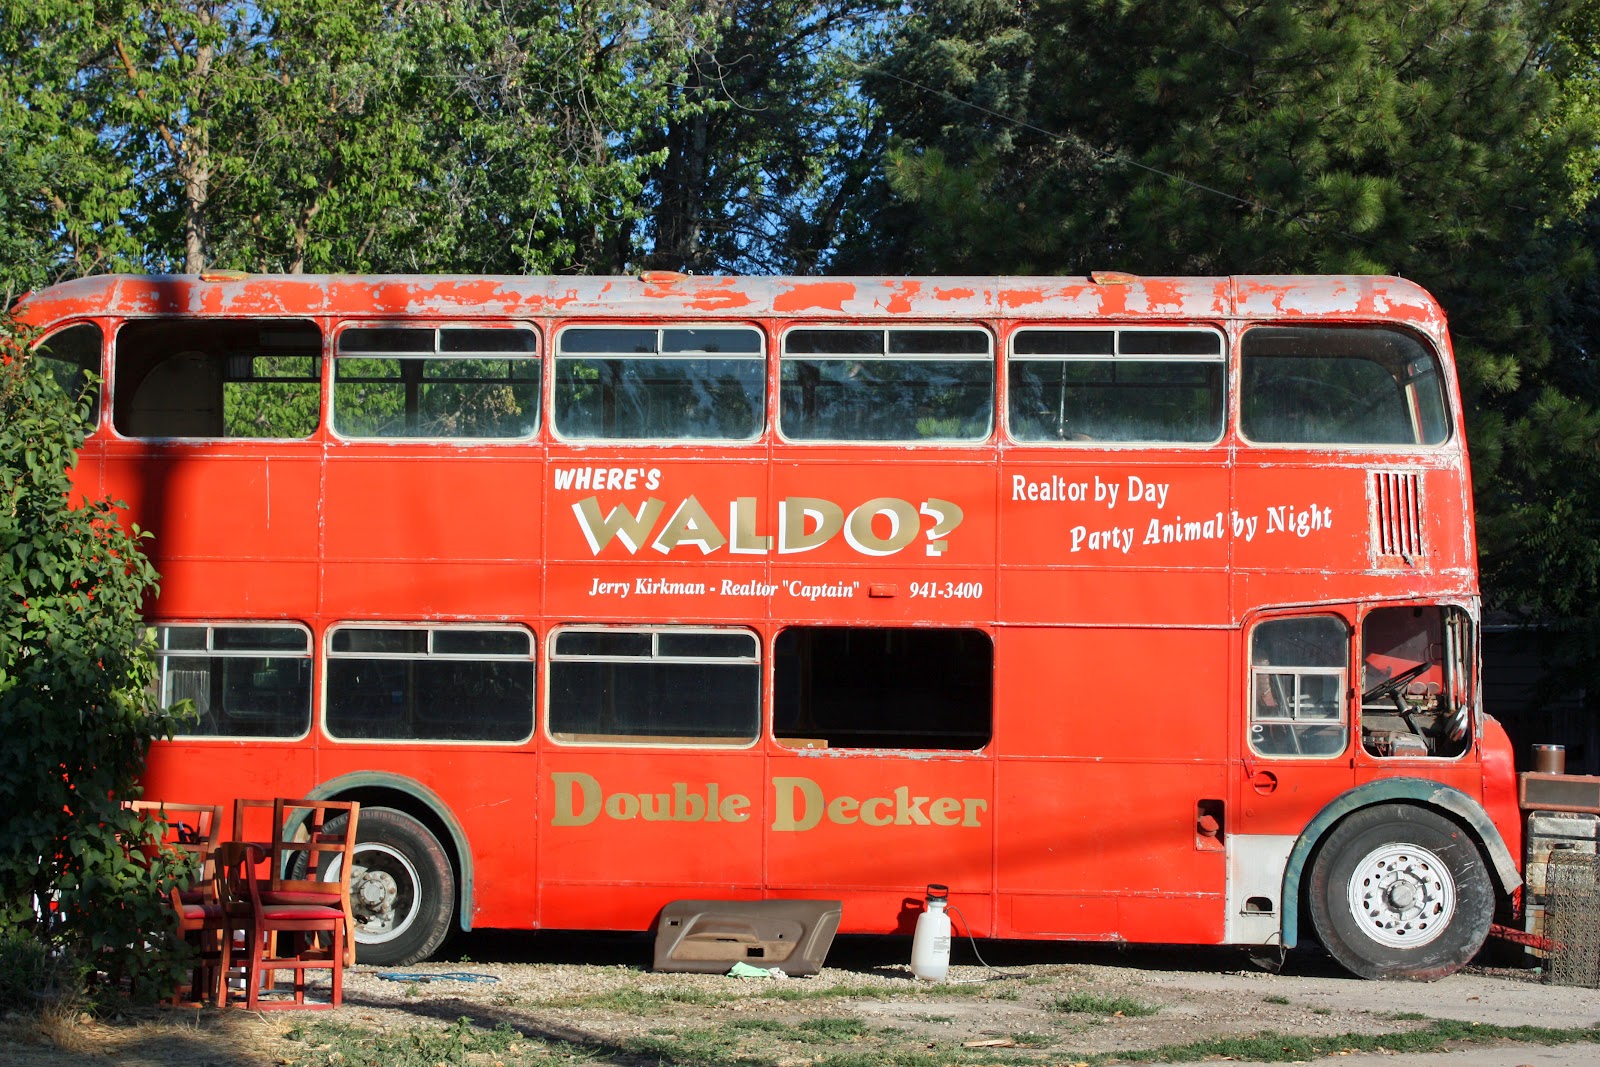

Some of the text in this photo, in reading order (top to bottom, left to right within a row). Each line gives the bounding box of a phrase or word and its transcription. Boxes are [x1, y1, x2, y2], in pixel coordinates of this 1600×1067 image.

[554, 467, 661, 490] WHERE'S
[1012, 475, 1169, 509] Realtor by Day
[571, 494, 964, 556] WALDO?
[1070, 503, 1332, 554] Party Animal by Night
[589, 578, 630, 597] Jerry
[634, 577, 705, 596] Kirkman
[720, 578, 779, 597] Realtor
[782, 579, 860, 601] "Captain"
[910, 582, 983, 599] 941-3400
[551, 772, 987, 831] Double Decker
